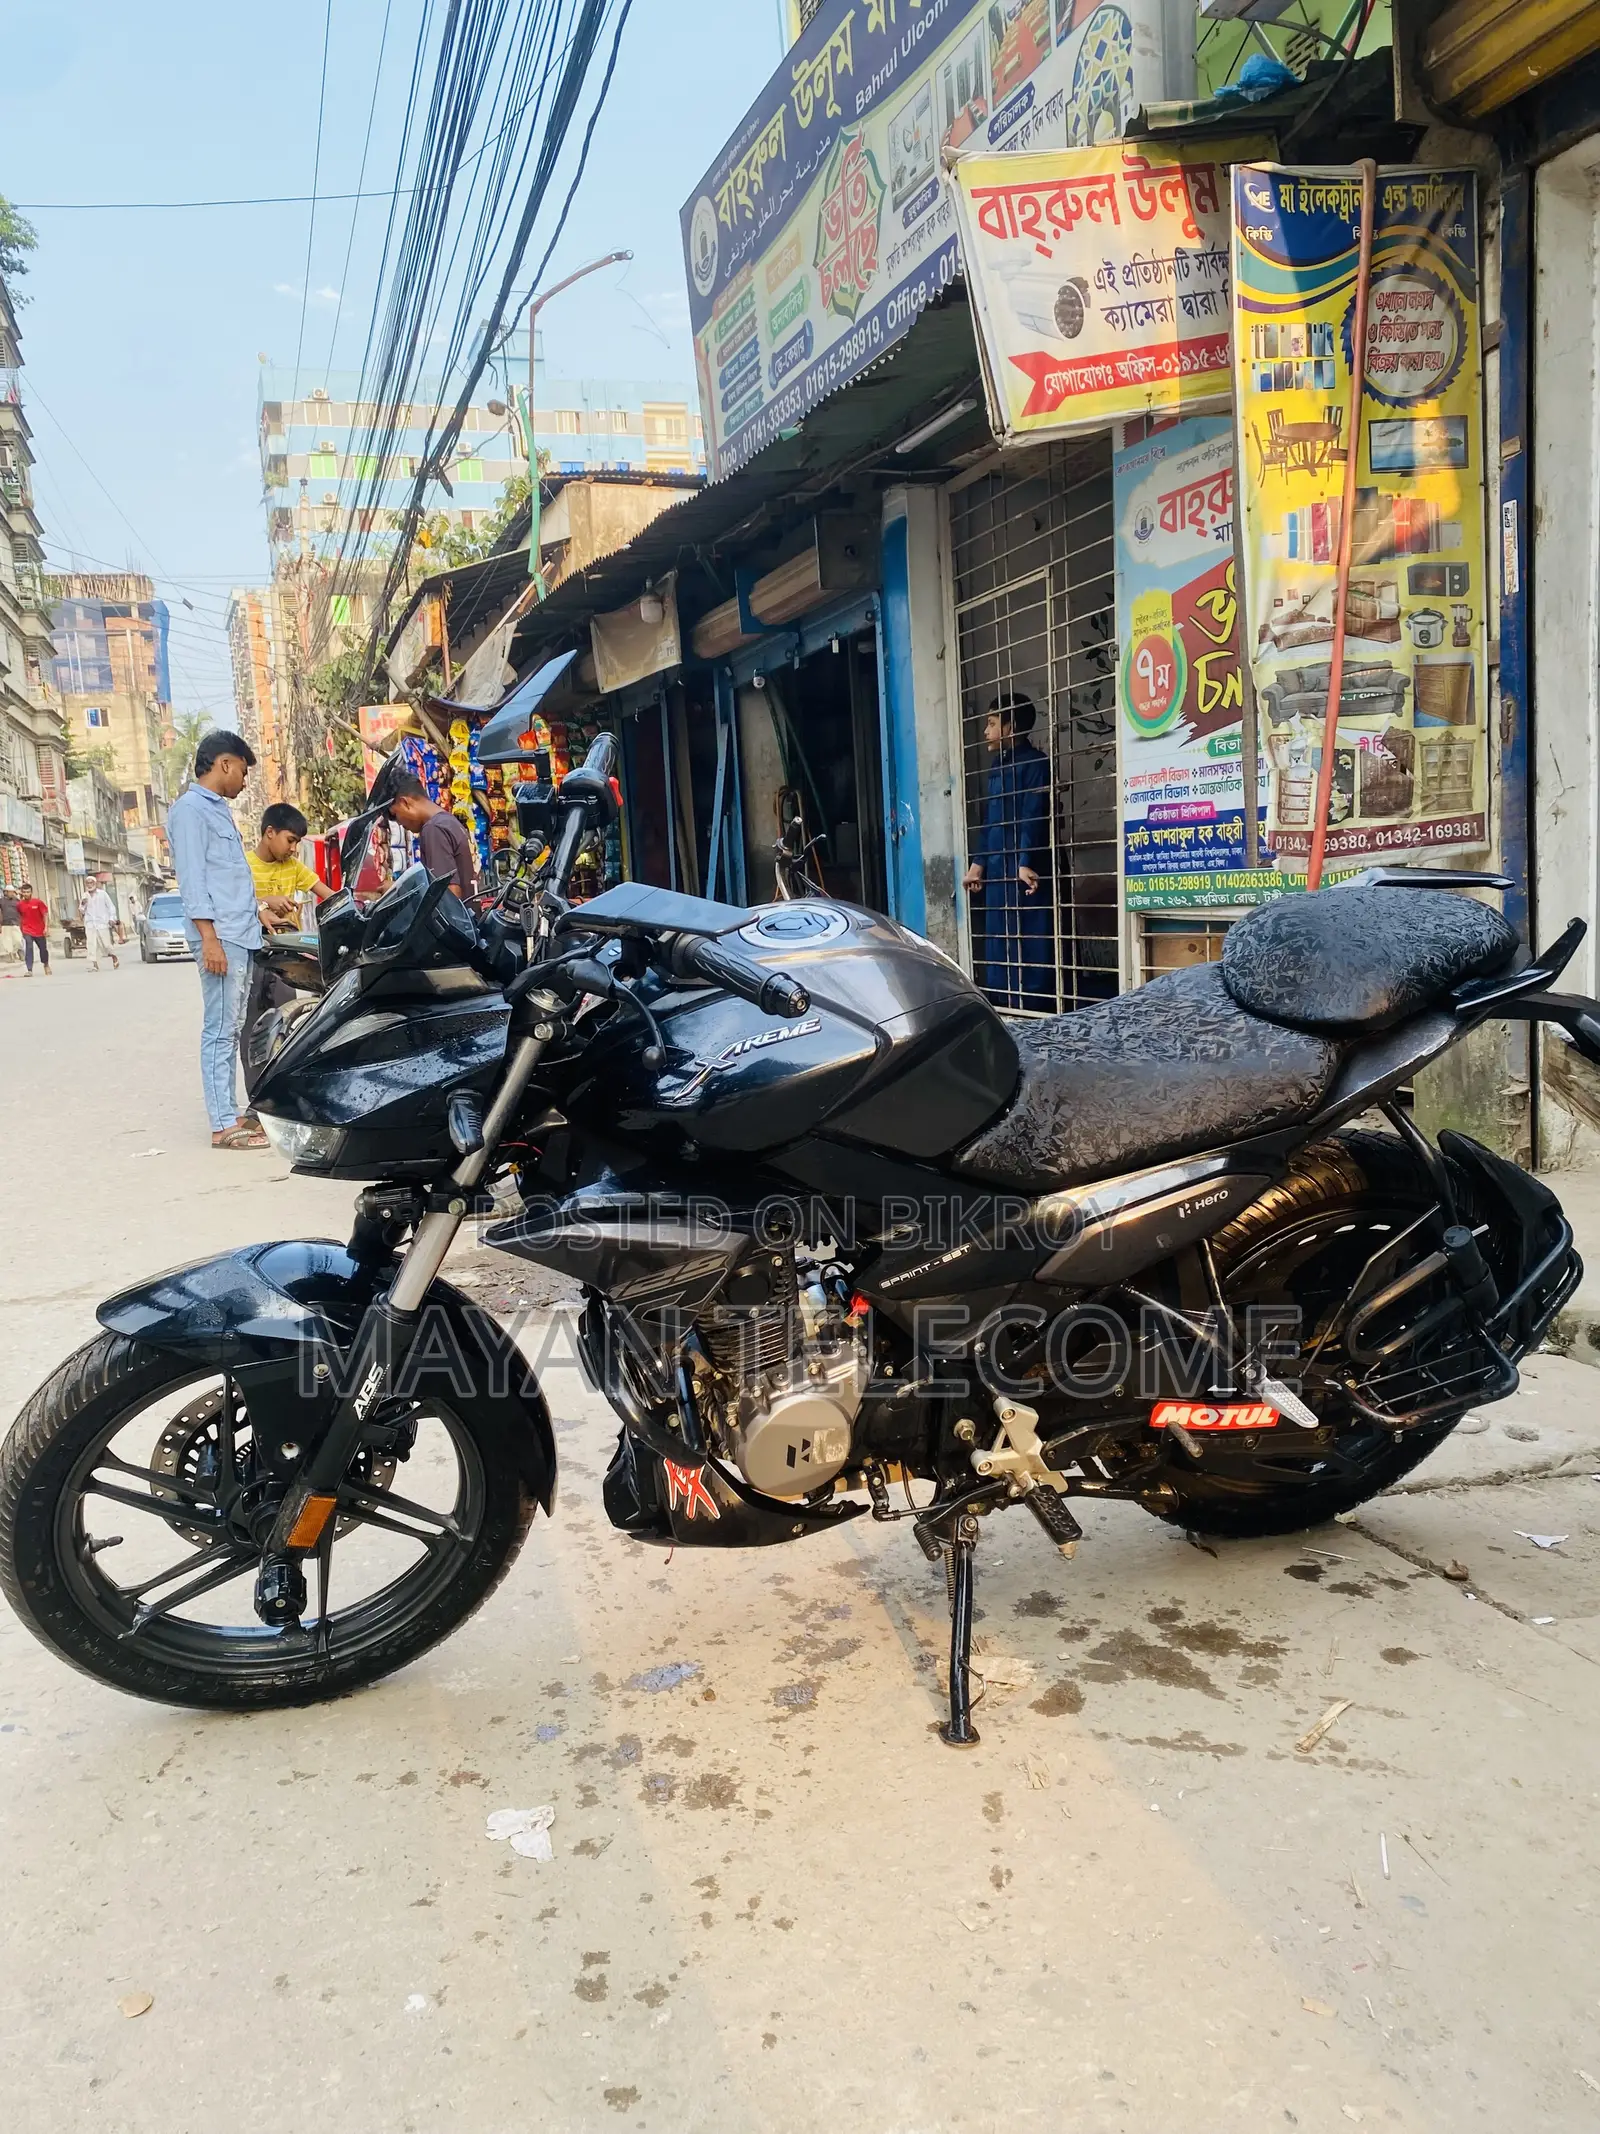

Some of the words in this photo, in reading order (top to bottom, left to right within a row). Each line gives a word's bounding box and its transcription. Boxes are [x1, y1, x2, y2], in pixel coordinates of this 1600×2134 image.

[856, 47, 897, 115] Bahrul
[1279, 183, 1296, 214] মা
[1094, 257, 1120, 296] এই
[1100, 294, 1175, 333] ক্যামেরা
[1177, 287, 1220, 320] দ্বারা
[720, 444, 738, 476] Mob
[805, 322, 884, 401] 01615-298919,
[886, 282, 927, 331] Office
[1503, 506, 1511, 529] GPS
[1164, 783, 1190, 800] বিভাগ
[1275, 833, 1372, 853] 01342-69380,
[1375, 821, 1480, 847] 01342-169381
[1126, 877, 1147, 893] Mob:
[1195, 1189, 1229, 1211] Hero
[353, 1361, 384, 1421] ABS
[1155, 1404, 1275, 1428] MOTUL
